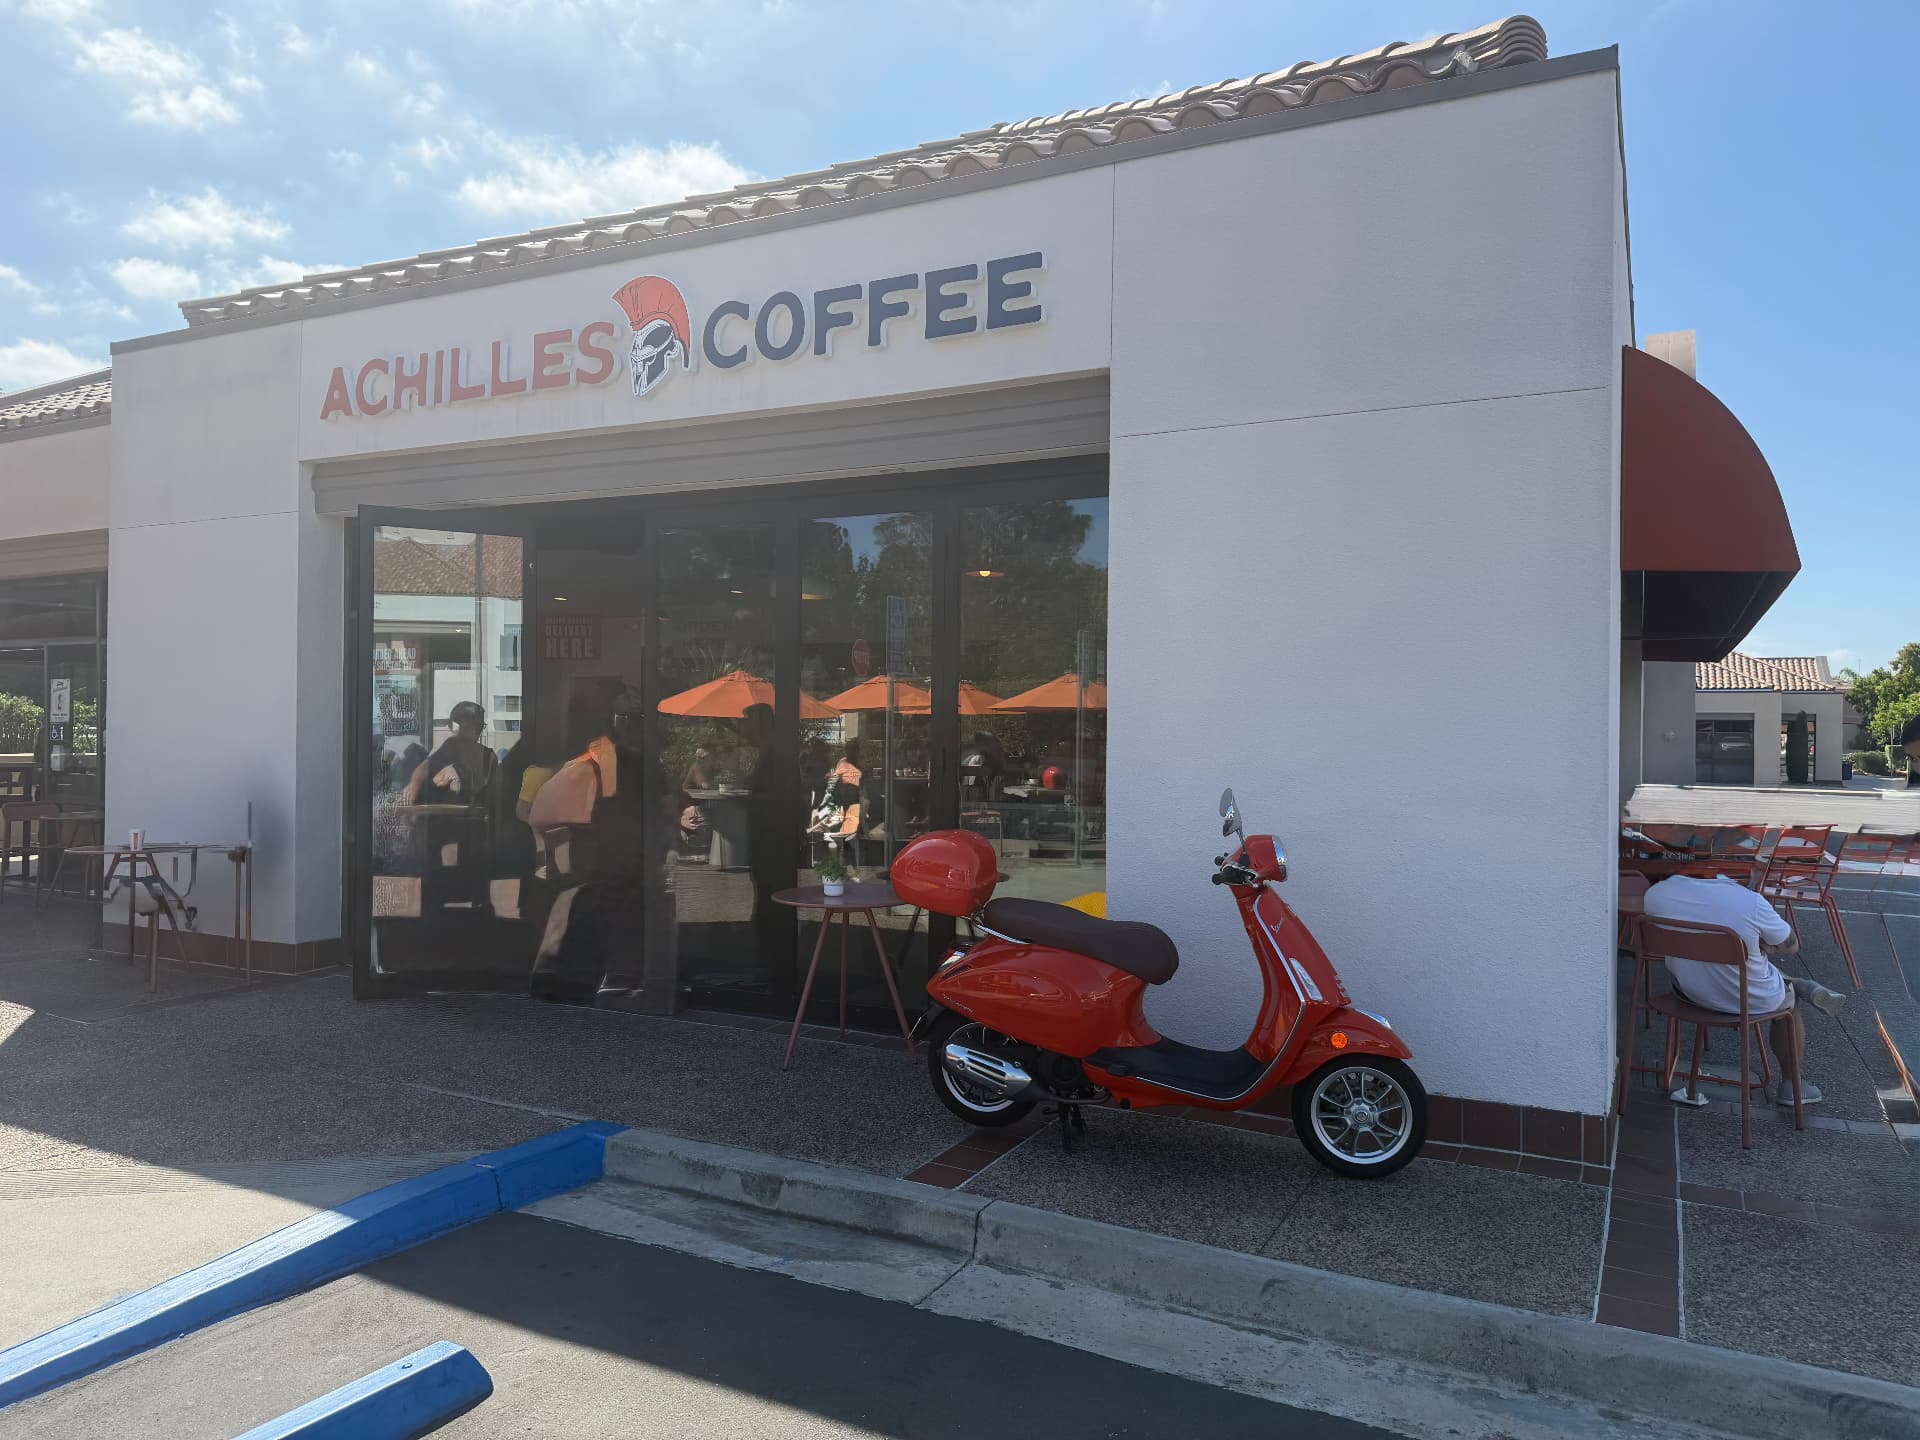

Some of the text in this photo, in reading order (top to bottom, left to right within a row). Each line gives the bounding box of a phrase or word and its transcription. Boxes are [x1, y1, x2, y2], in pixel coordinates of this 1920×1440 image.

[319, 251, 1044, 420] ACHILLES COFFEE
[545, 625, 593, 636] DELIVERY
[545, 638, 593, 658] HERE
